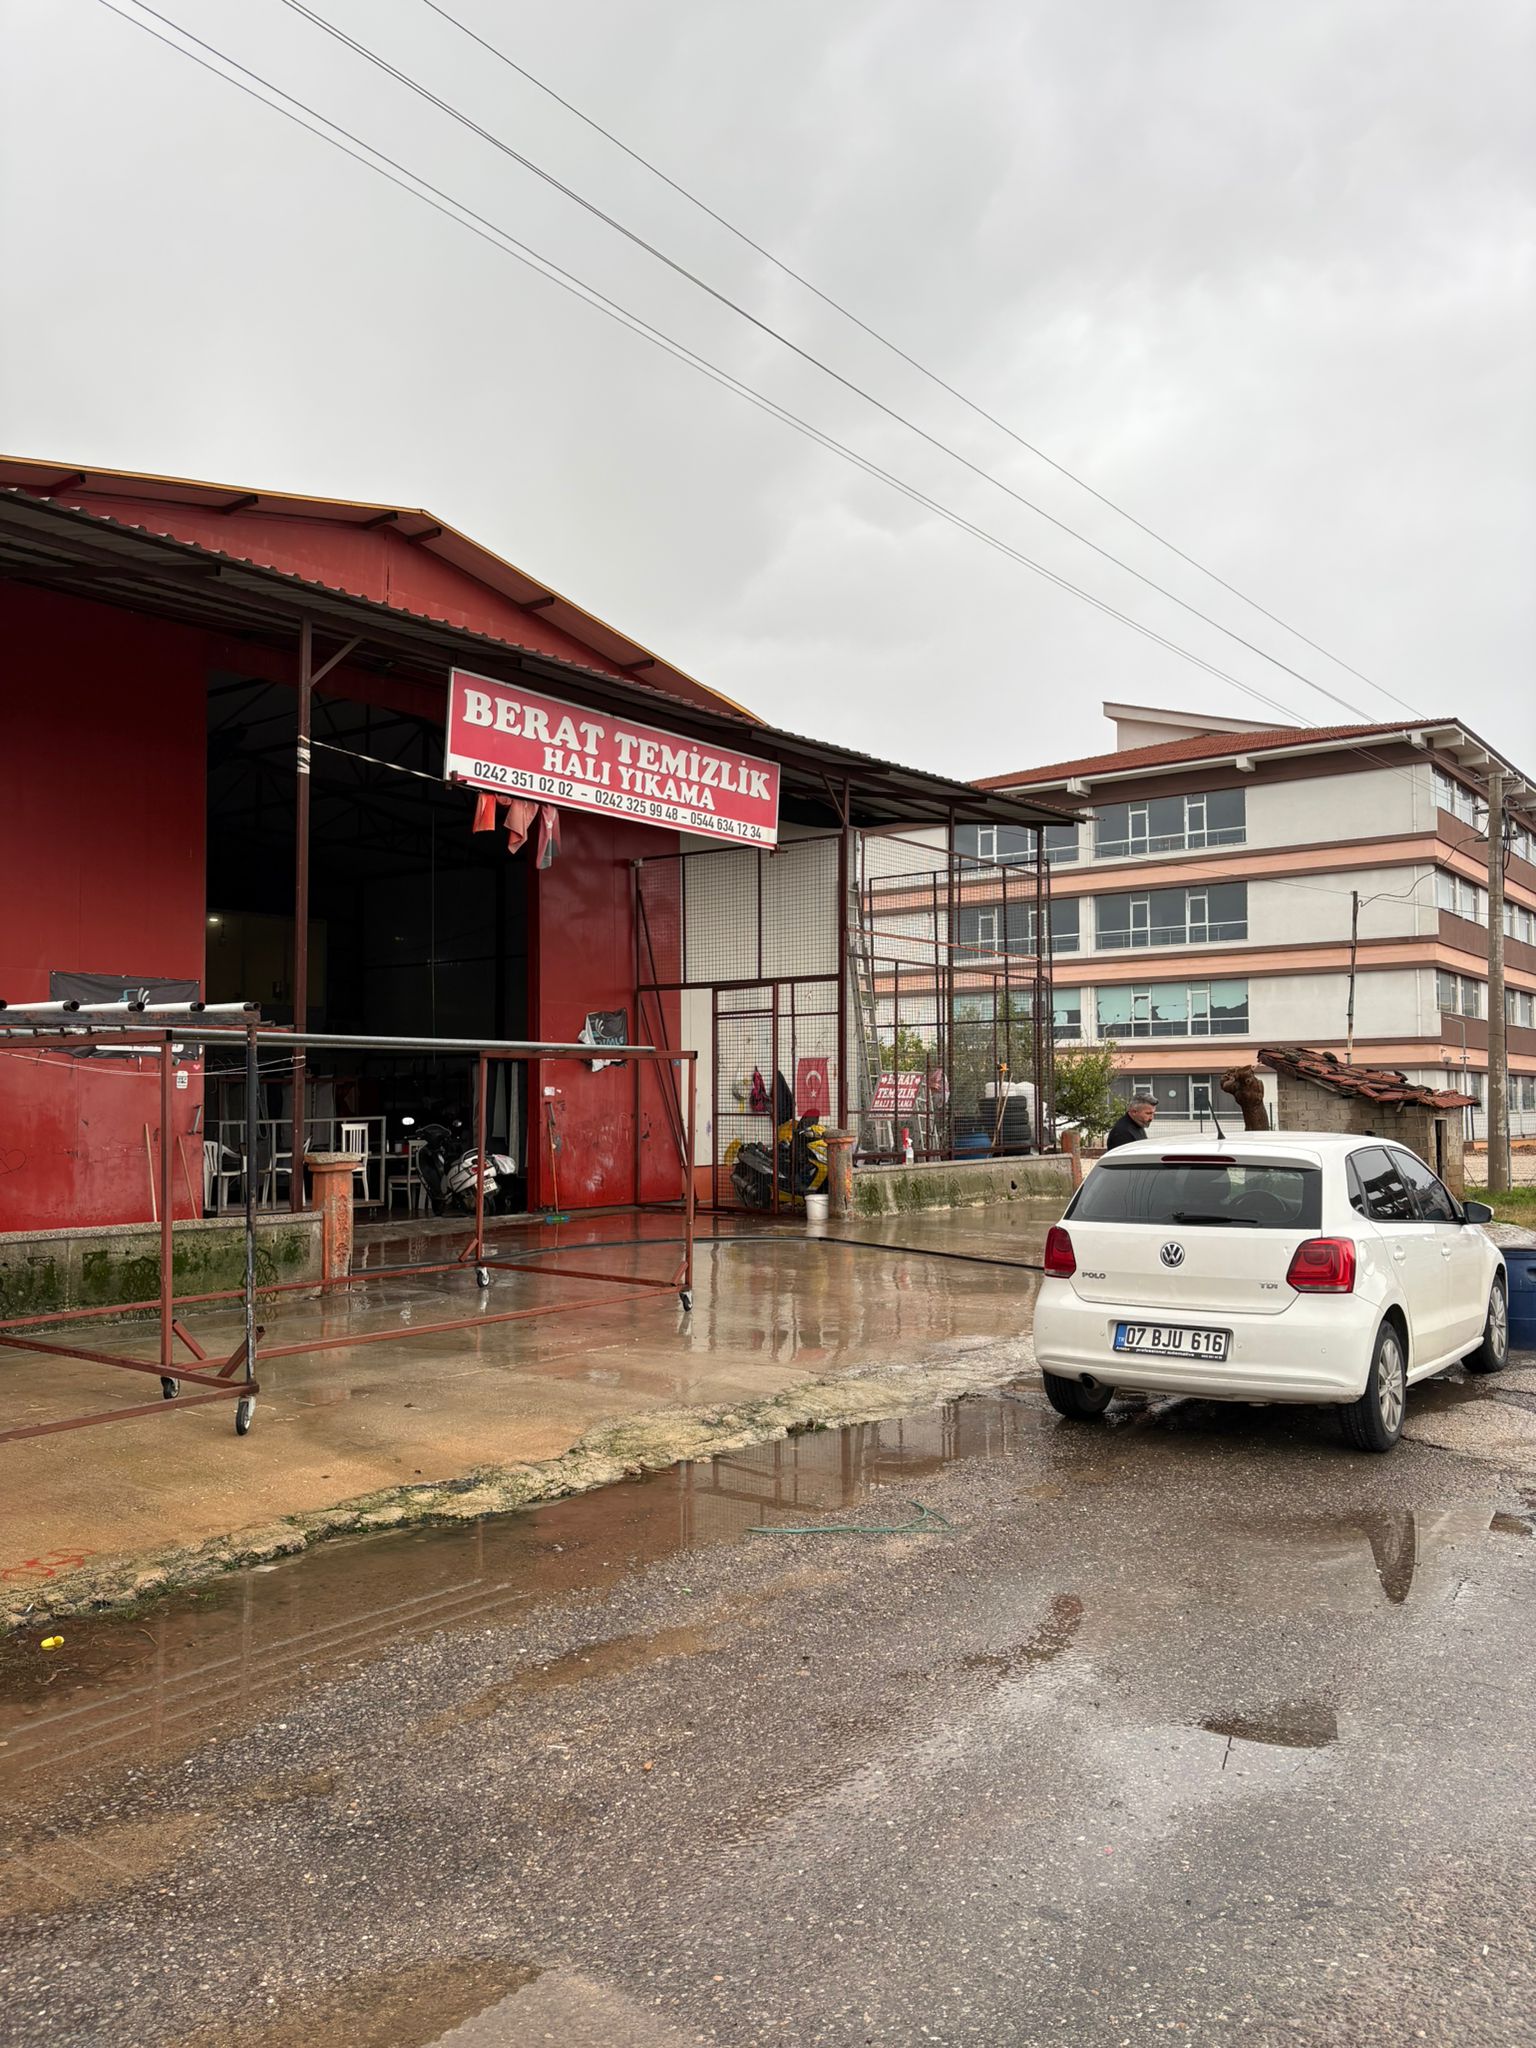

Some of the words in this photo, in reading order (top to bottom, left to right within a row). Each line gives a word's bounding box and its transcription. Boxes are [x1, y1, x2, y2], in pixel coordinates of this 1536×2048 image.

[463, 688, 605, 755] BERAT
[614, 731, 771, 800] TEMİZLİK
[474, 761, 507, 783] 0242
[511, 770, 533, 788] 351
[539, 776, 554, 793] 02
[558, 781, 573, 798] 02
[595, 789, 623, 809] 0242
[626, 797, 646, 814] 325
[650, 803, 662, 817] 99
[665, 806, 678, 821] 48
[690, 811, 714, 829] 0544
[716, 818, 734, 835] 634
[738, 822, 748, 837] 12
[751, 825, 762, 839] 34
[542, 747, 611, 785] HALI
[618, 765, 716, 811] YIKAMA
[1081, 1271, 1106, 1280] POLO
[1126, 1327, 1146, 1346] 07
[1151, 1328, 1183, 1349] BJU
[1191, 1332, 1223, 1353] 616
